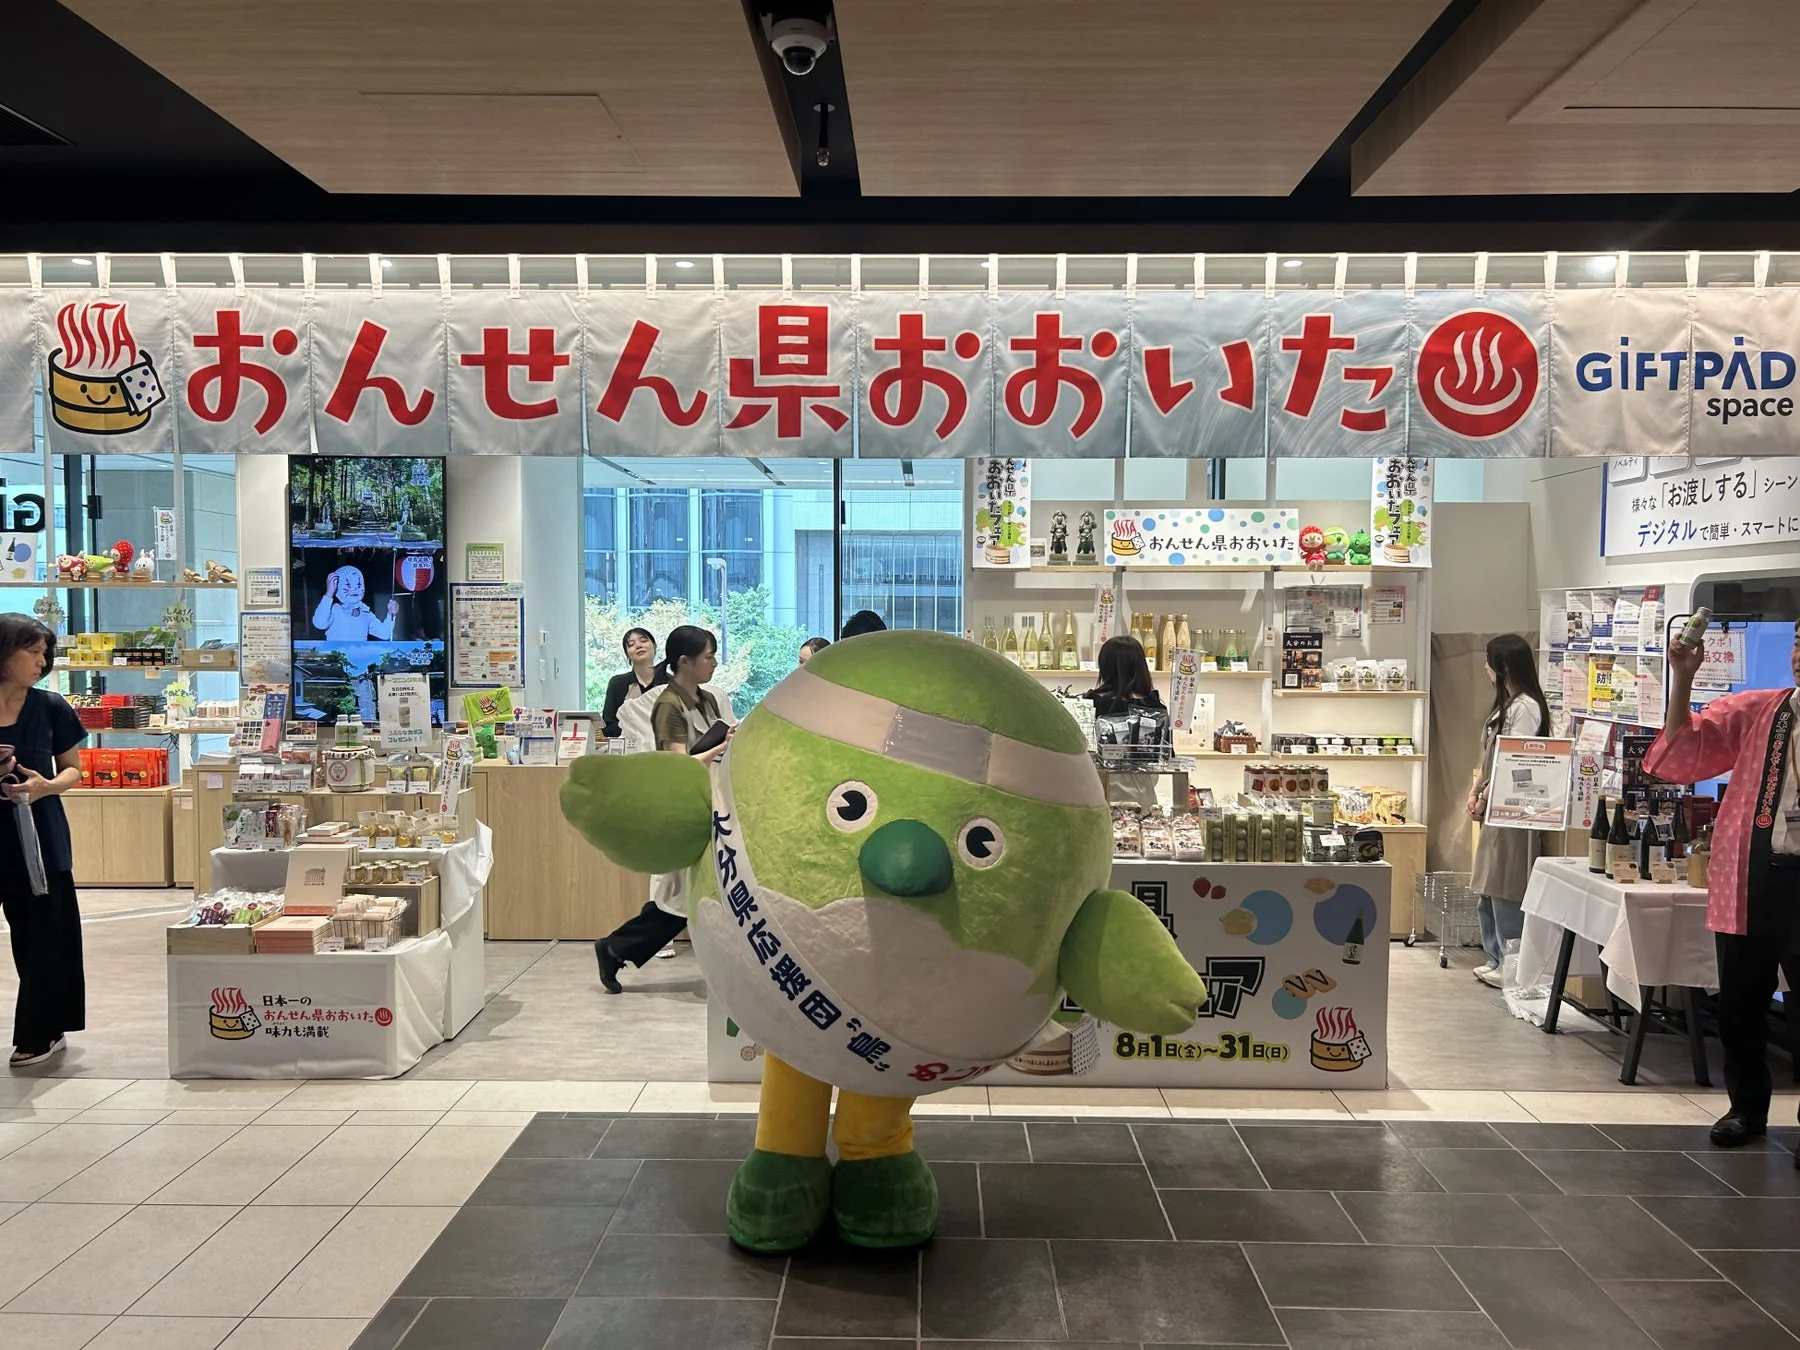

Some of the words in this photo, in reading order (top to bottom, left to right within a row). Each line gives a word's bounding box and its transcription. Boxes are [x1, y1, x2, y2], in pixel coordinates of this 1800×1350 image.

[57, 302, 137, 369] OITA
[187, 304, 1393, 439] おんせん県おおいた
[1706, 397, 1794, 425] space
[1149, 534, 1294, 552] おんせん県おおいた
[1638, 516, 1799, 547] デジタルで簡単・スマートに
[263, 995, 312, 1006] 日本一の
[264, 1009, 374, 1023] おんせん県おおいた
[265, 1025, 330, 1038] 味力も満載
